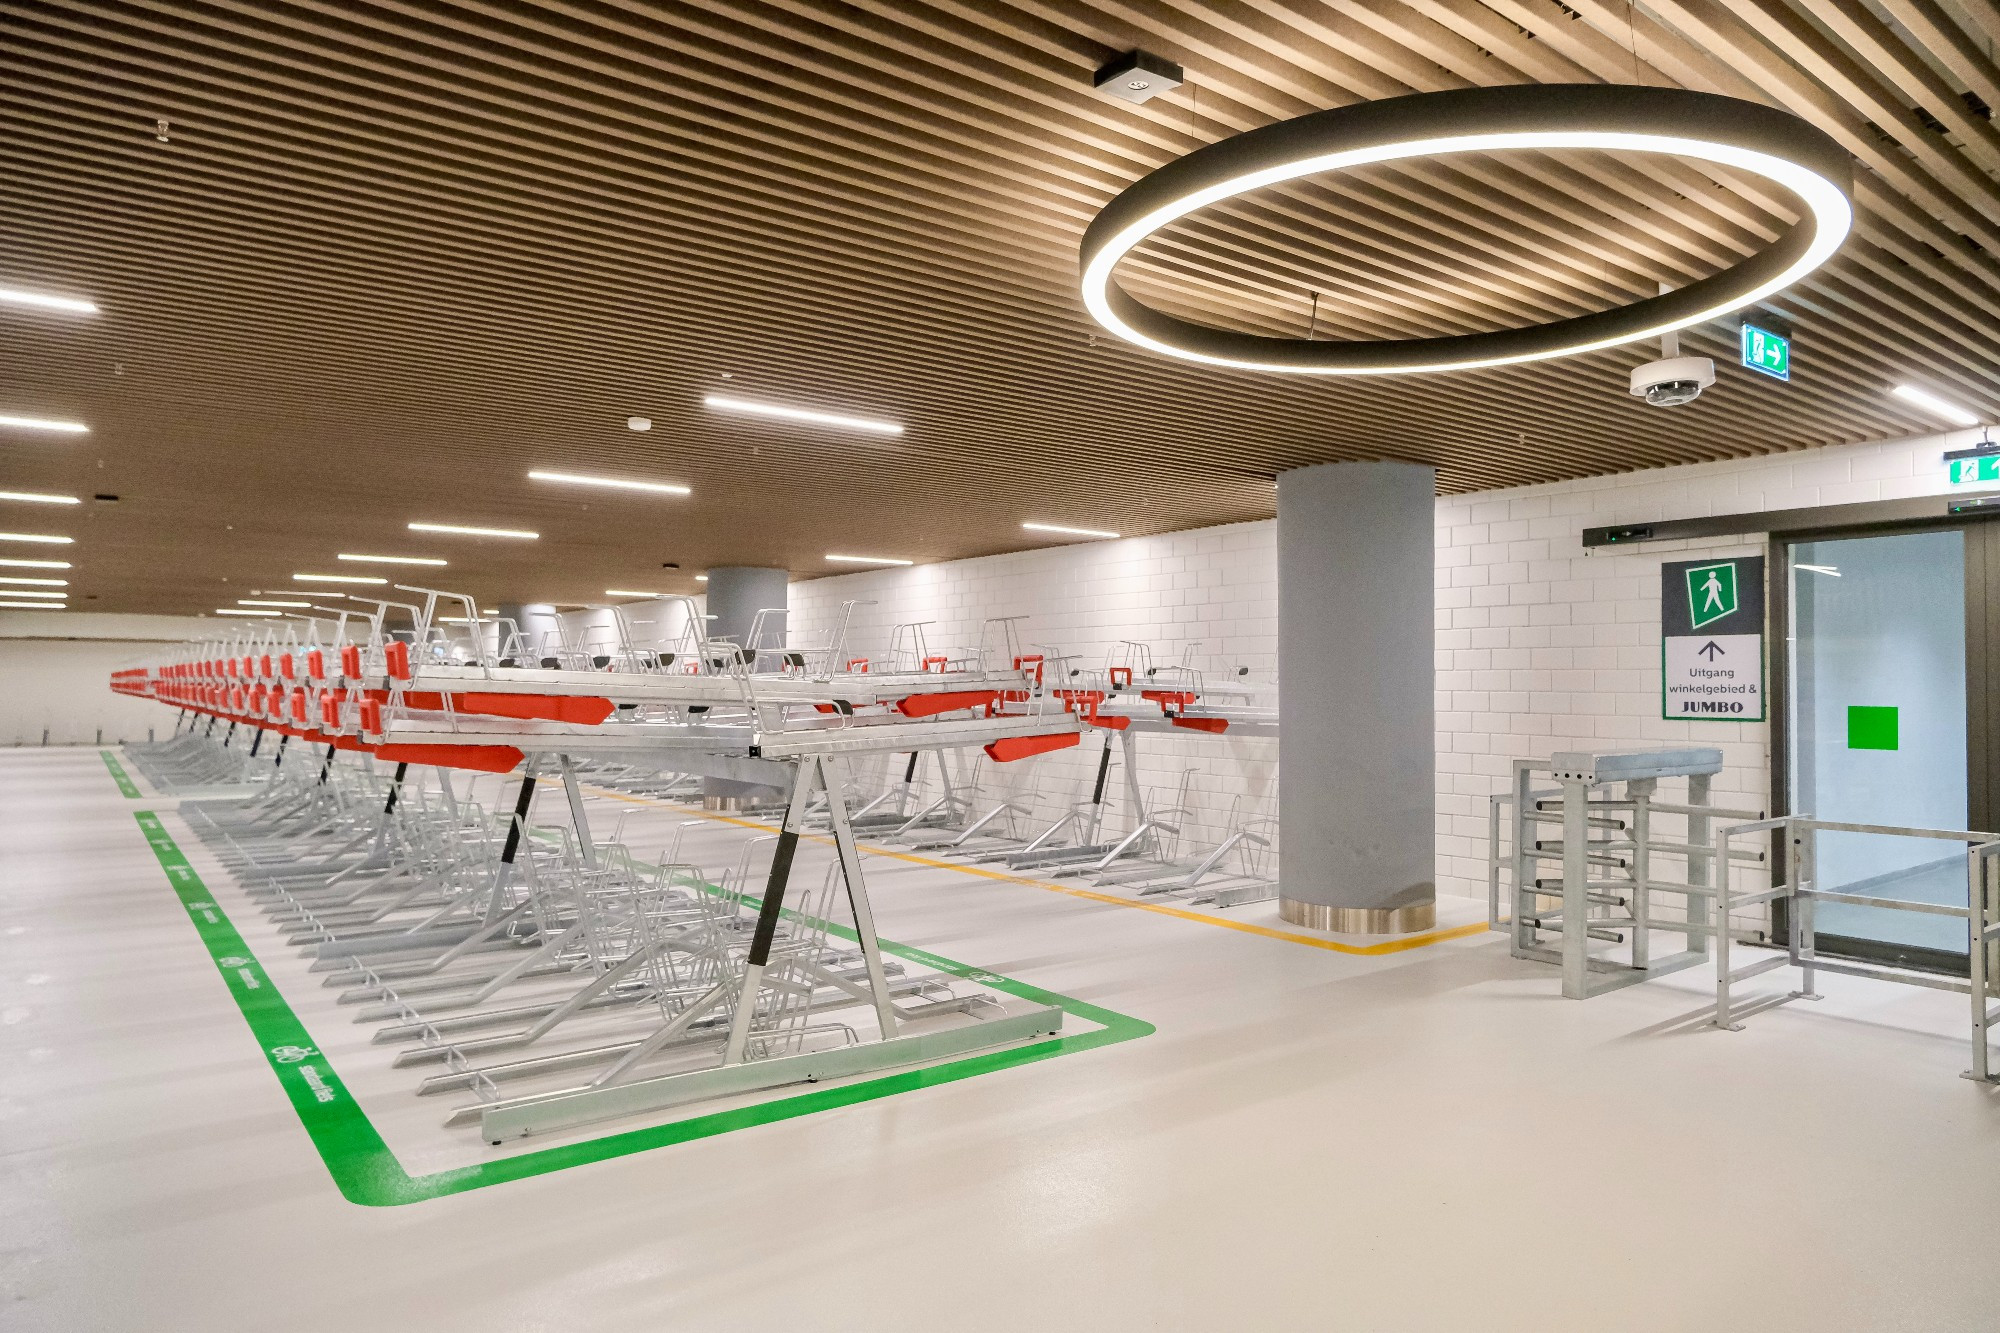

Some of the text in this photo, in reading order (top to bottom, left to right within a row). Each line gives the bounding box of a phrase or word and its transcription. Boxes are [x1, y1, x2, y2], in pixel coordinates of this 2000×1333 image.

[1689, 668, 1735, 679] Uitgang
[1669, 684, 1757, 695] winkelgebied &
[1681, 701, 1744, 713] JUMBO
